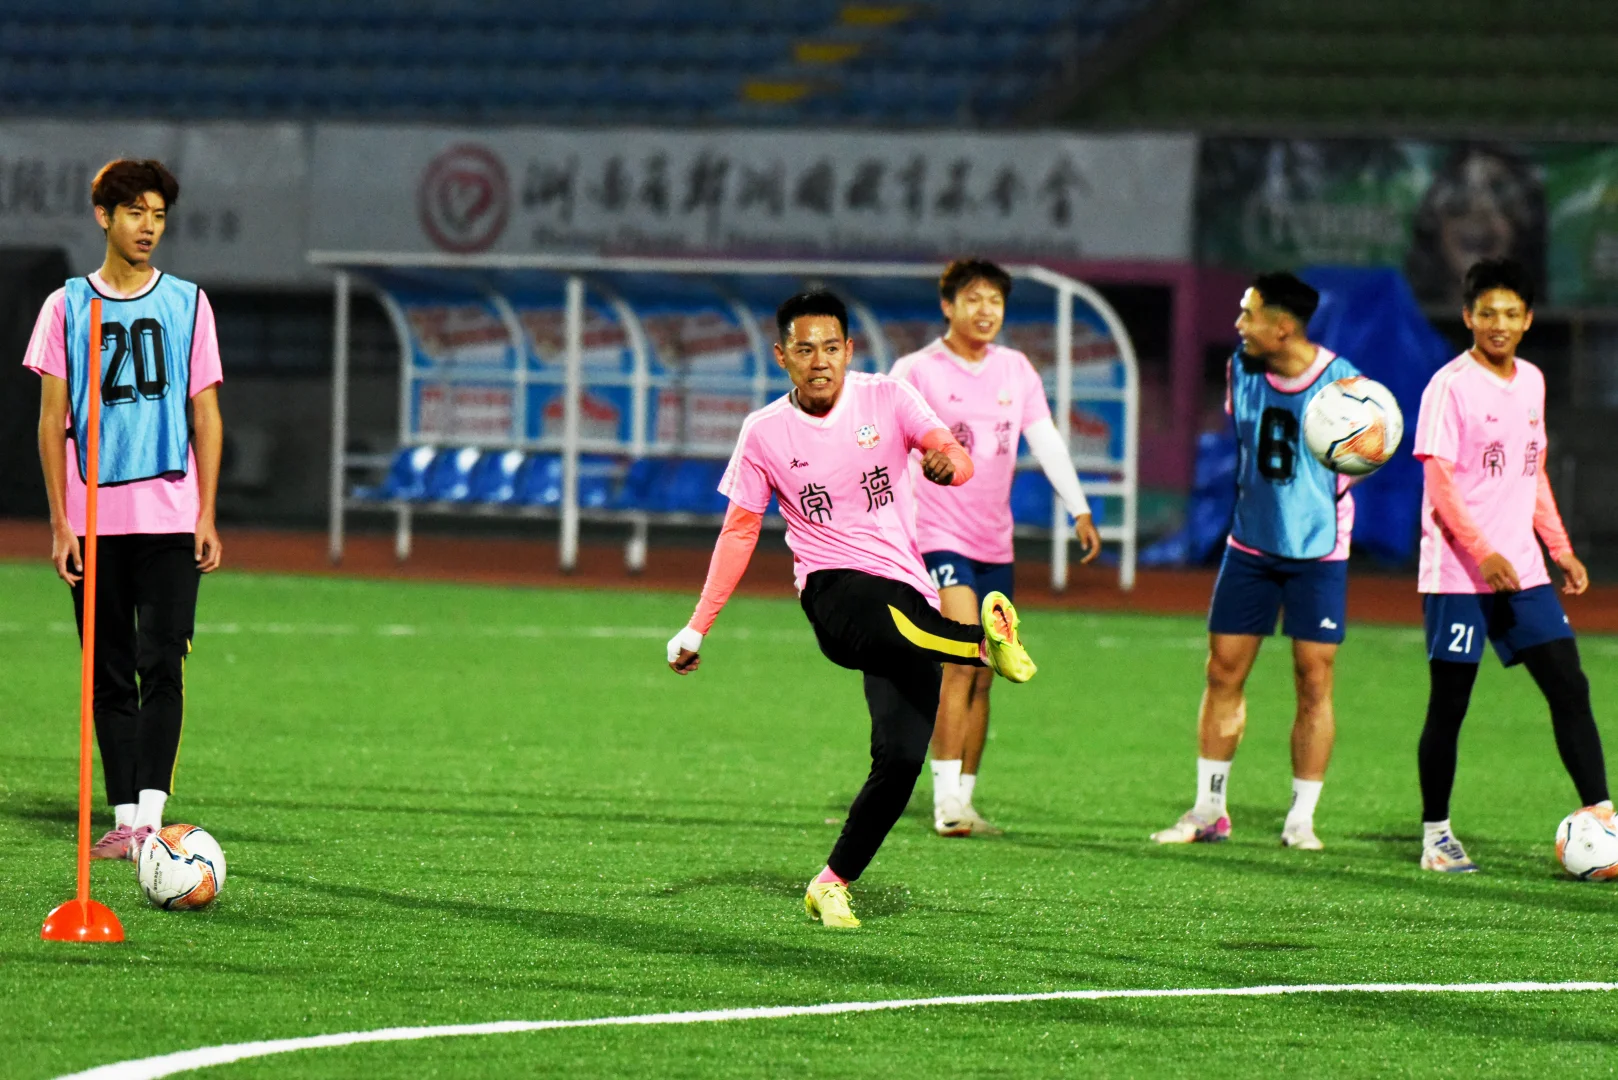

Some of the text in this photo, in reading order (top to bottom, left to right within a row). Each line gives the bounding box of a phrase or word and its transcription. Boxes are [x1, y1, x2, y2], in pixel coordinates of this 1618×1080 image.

[101, 317, 170, 406] 20
[1257, 406, 1300, 486] 6
[930, 563, 958, 590] 12
[1448, 622, 1474, 654] 21
